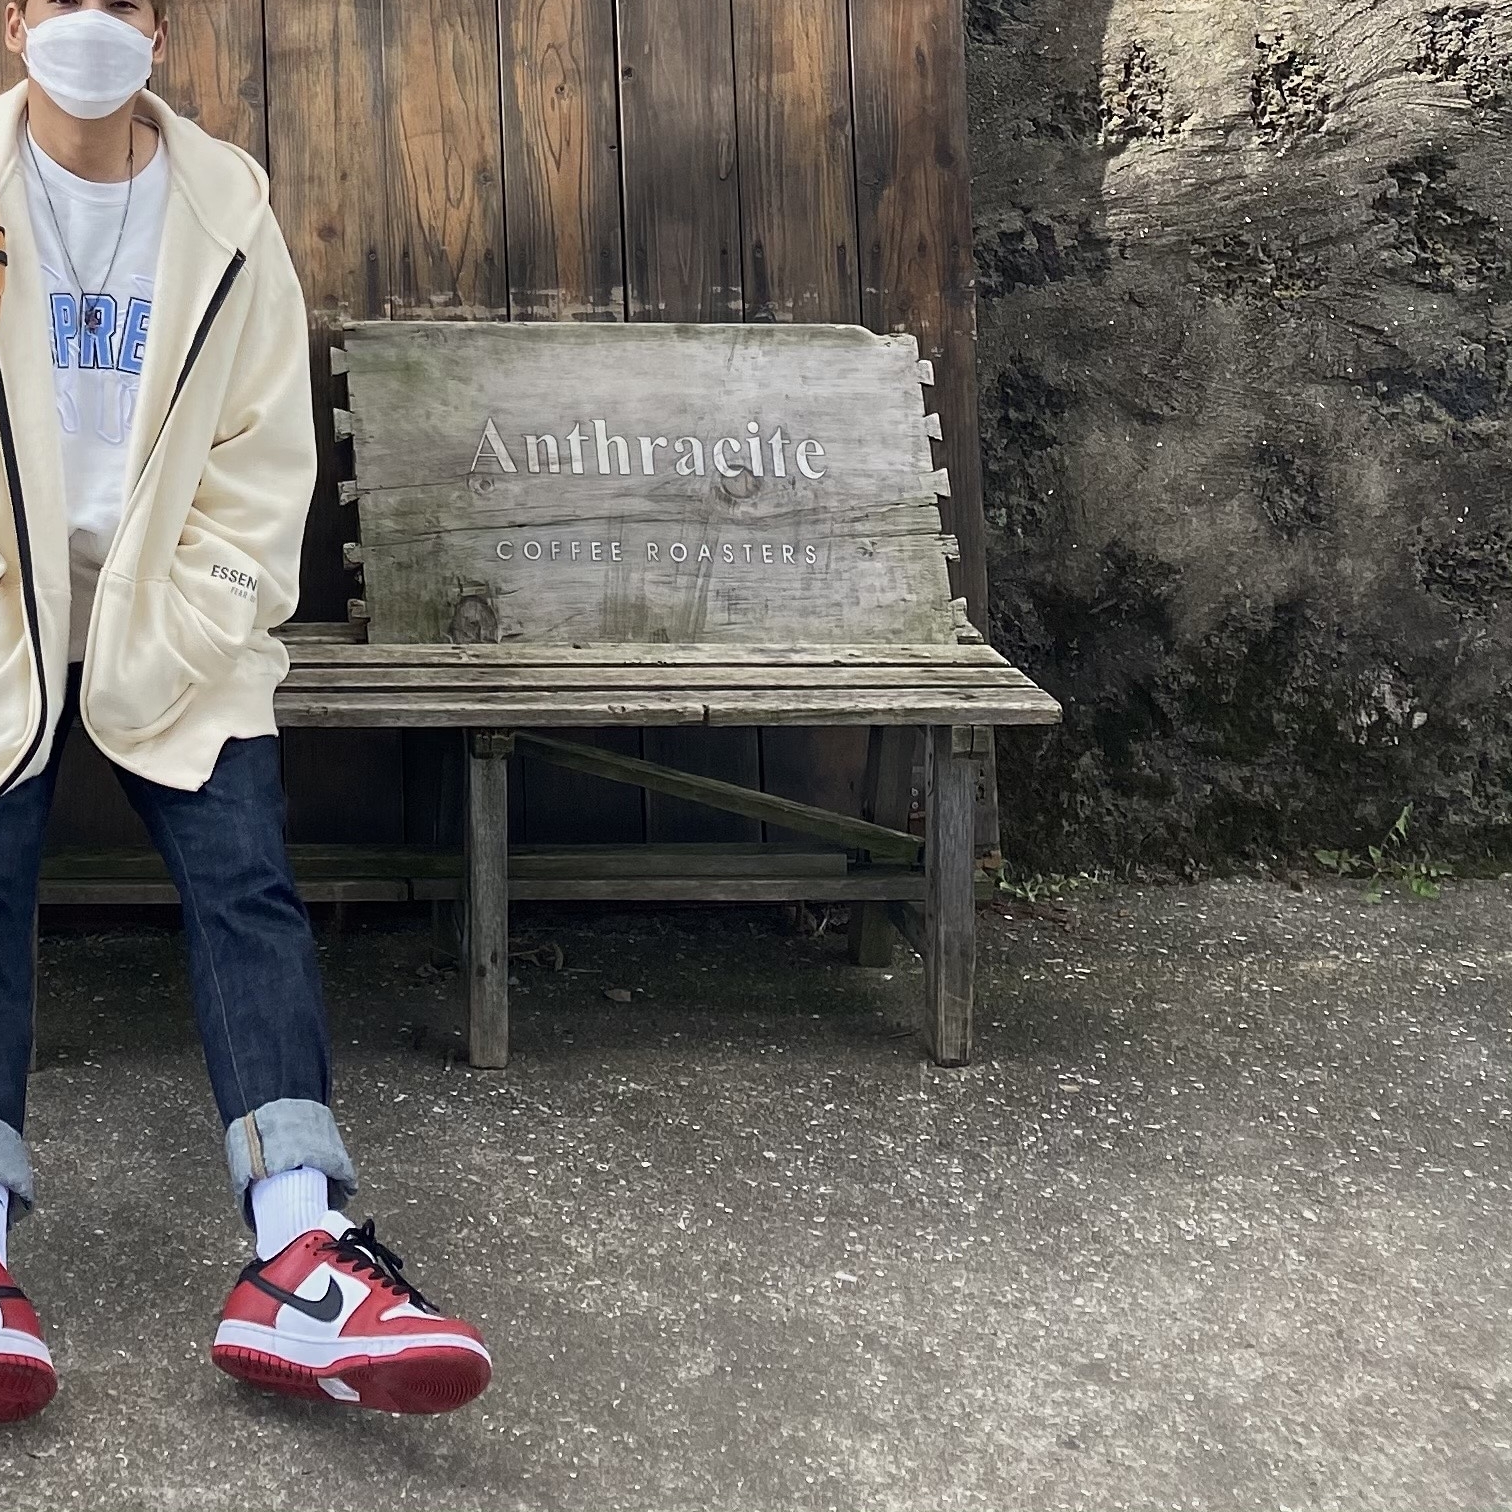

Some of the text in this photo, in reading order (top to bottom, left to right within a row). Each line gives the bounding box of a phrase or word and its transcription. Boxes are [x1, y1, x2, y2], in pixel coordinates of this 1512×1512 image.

[469, 417, 828, 480] Anthracite
[496, 540, 818, 565] COFFEE ROASTERS
[210, 564, 258, 592] ESSEN
